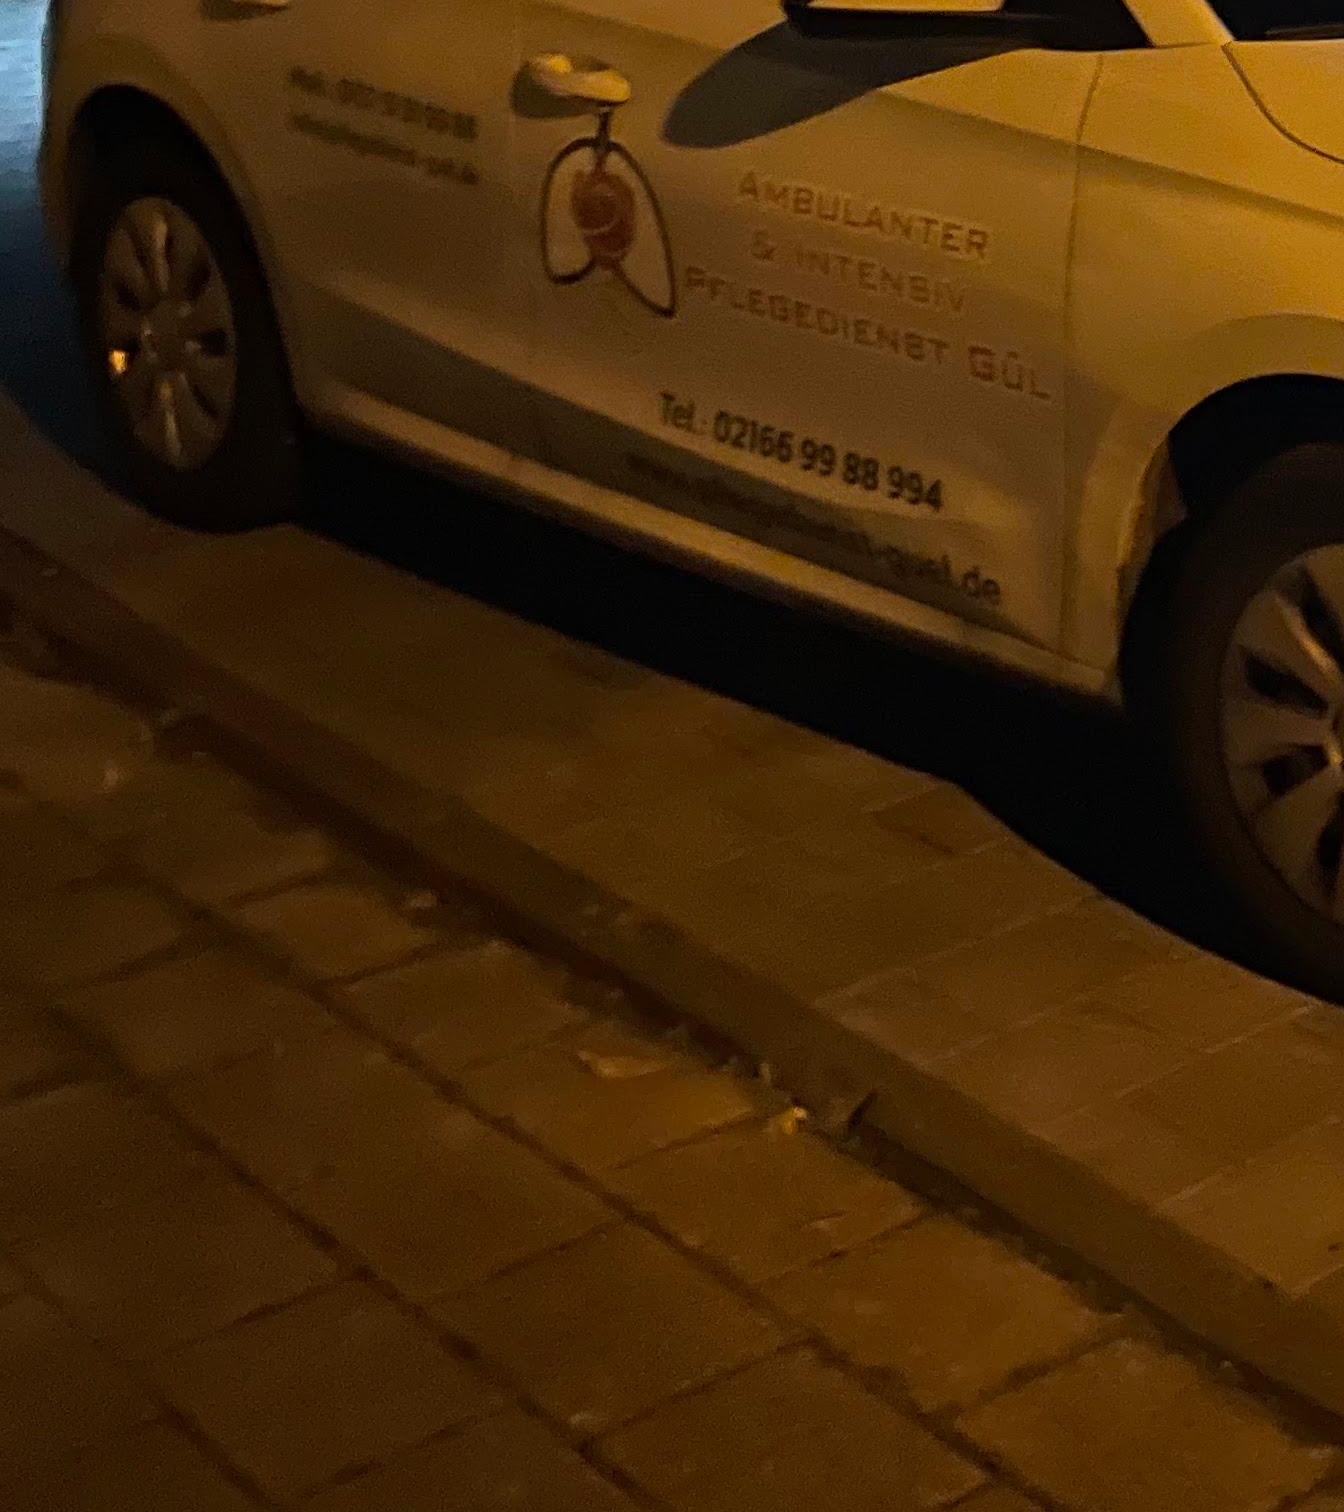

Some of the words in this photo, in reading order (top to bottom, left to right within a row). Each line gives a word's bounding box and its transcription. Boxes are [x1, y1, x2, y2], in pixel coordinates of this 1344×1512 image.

[737, 170, 991, 262] AMBULANTER
[752, 228, 777, 262] &
[796, 249, 965, 314] INTENSIV
[685, 265, 951, 365] PFLEGEDIENST
[967, 345, 1052, 401] GÜL
[712, 408, 794, 464] 02166
[799, 437, 837, 477] 99
[842, 451, 880, 491] 88
[886, 464, 945, 513] 994
